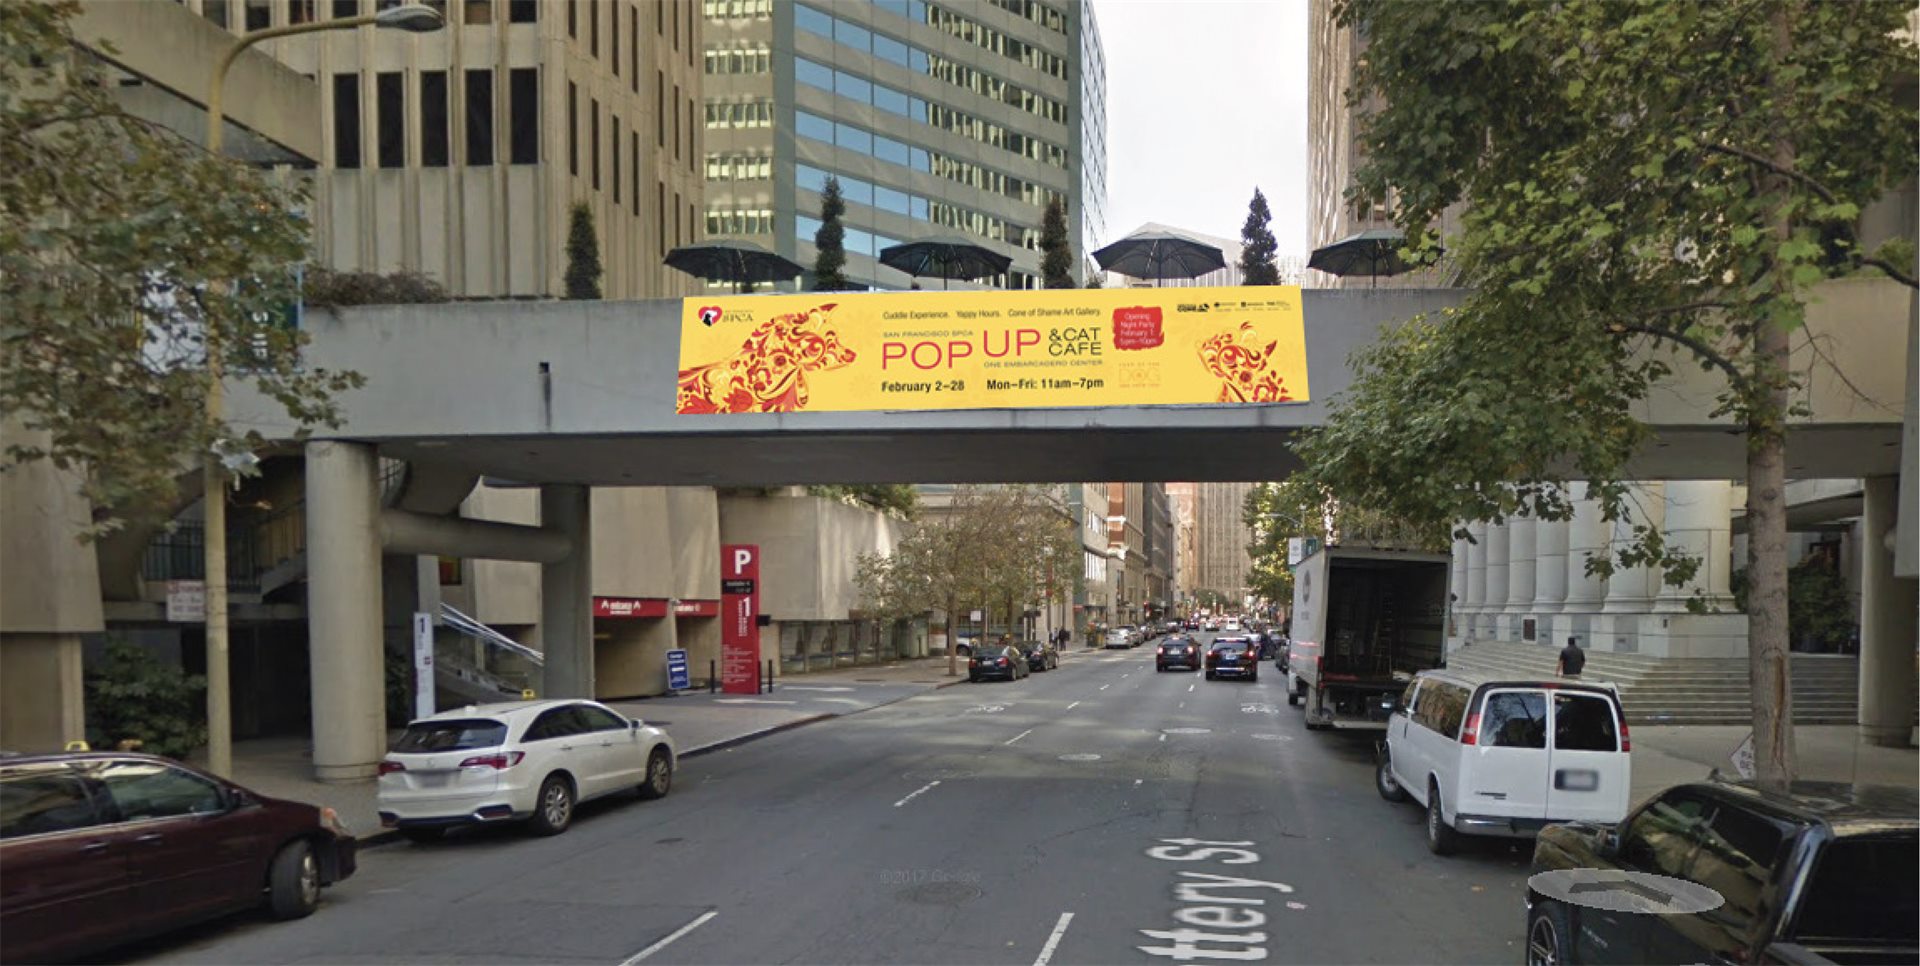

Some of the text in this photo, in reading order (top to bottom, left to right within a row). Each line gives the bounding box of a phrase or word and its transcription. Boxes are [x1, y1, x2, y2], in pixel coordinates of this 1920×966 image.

[883, 311, 908, 320] Cuddle
[956, 310, 977, 319] Yappy
[1008, 308, 1027, 317] Cone
[1028, 308, 1036, 317] of
[1037, 308, 1061, 317] Shame
[1063, 308, 1074, 316] Art
[1124, 313, 1151, 321] Opening
[1121, 321, 1155, 330] Night Party
[1048, 327, 1101, 341] &CAT
[881, 328, 1041, 370] POP UP
[1048, 342, 1102, 356] CAFE
[983, 358, 1103, 368] ONE EMBARCADERO CENTER
[881, 380, 965, 393] February 2–28
[1041, 377, 1104, 390] 11am–7pm
[734, 549, 751, 575] P
[743, 596, 751, 616] 1
[420, 616, 425, 633] 1
[1145, 838, 1260, 864] St
